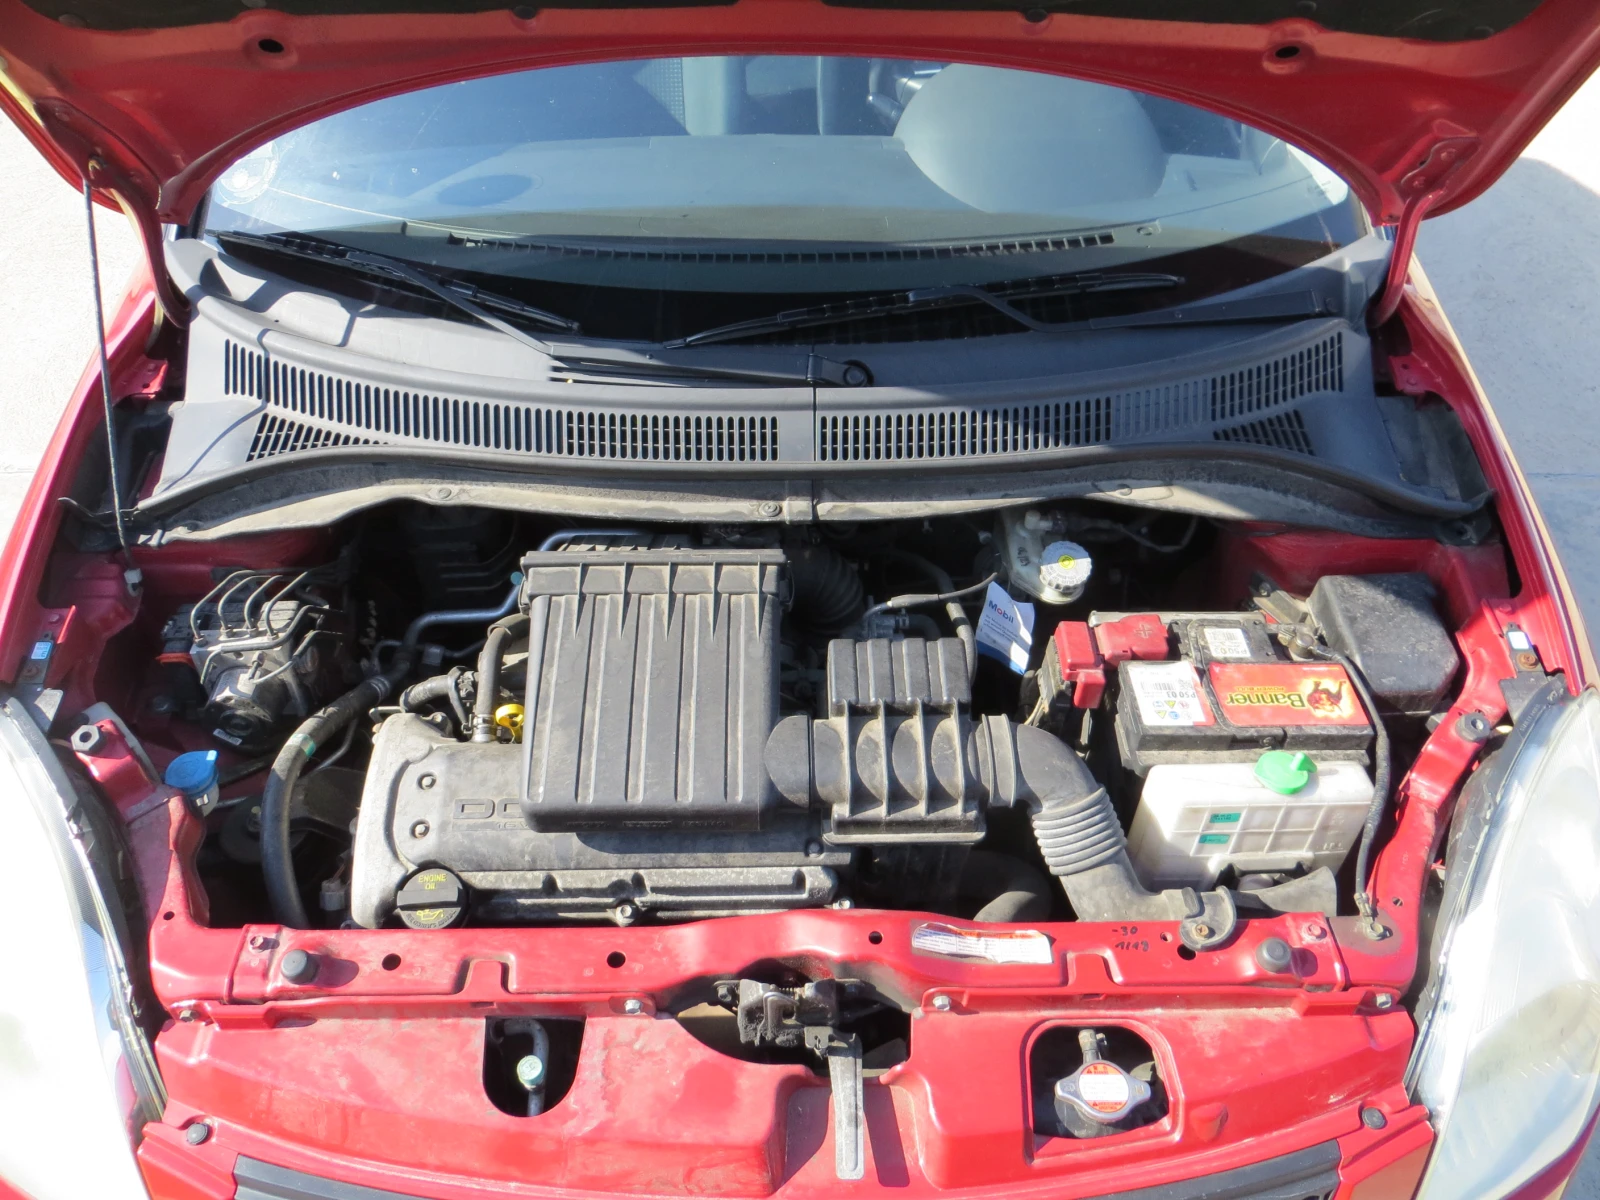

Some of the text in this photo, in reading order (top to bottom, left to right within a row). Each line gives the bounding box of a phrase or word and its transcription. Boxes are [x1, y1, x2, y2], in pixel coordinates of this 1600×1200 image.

[988, 599, 1014, 624] Mobil
[1226, 692, 1306, 708] Banner
[418, 873, 447, 883] ENGINE
[425, 882, 436, 890] OIL
